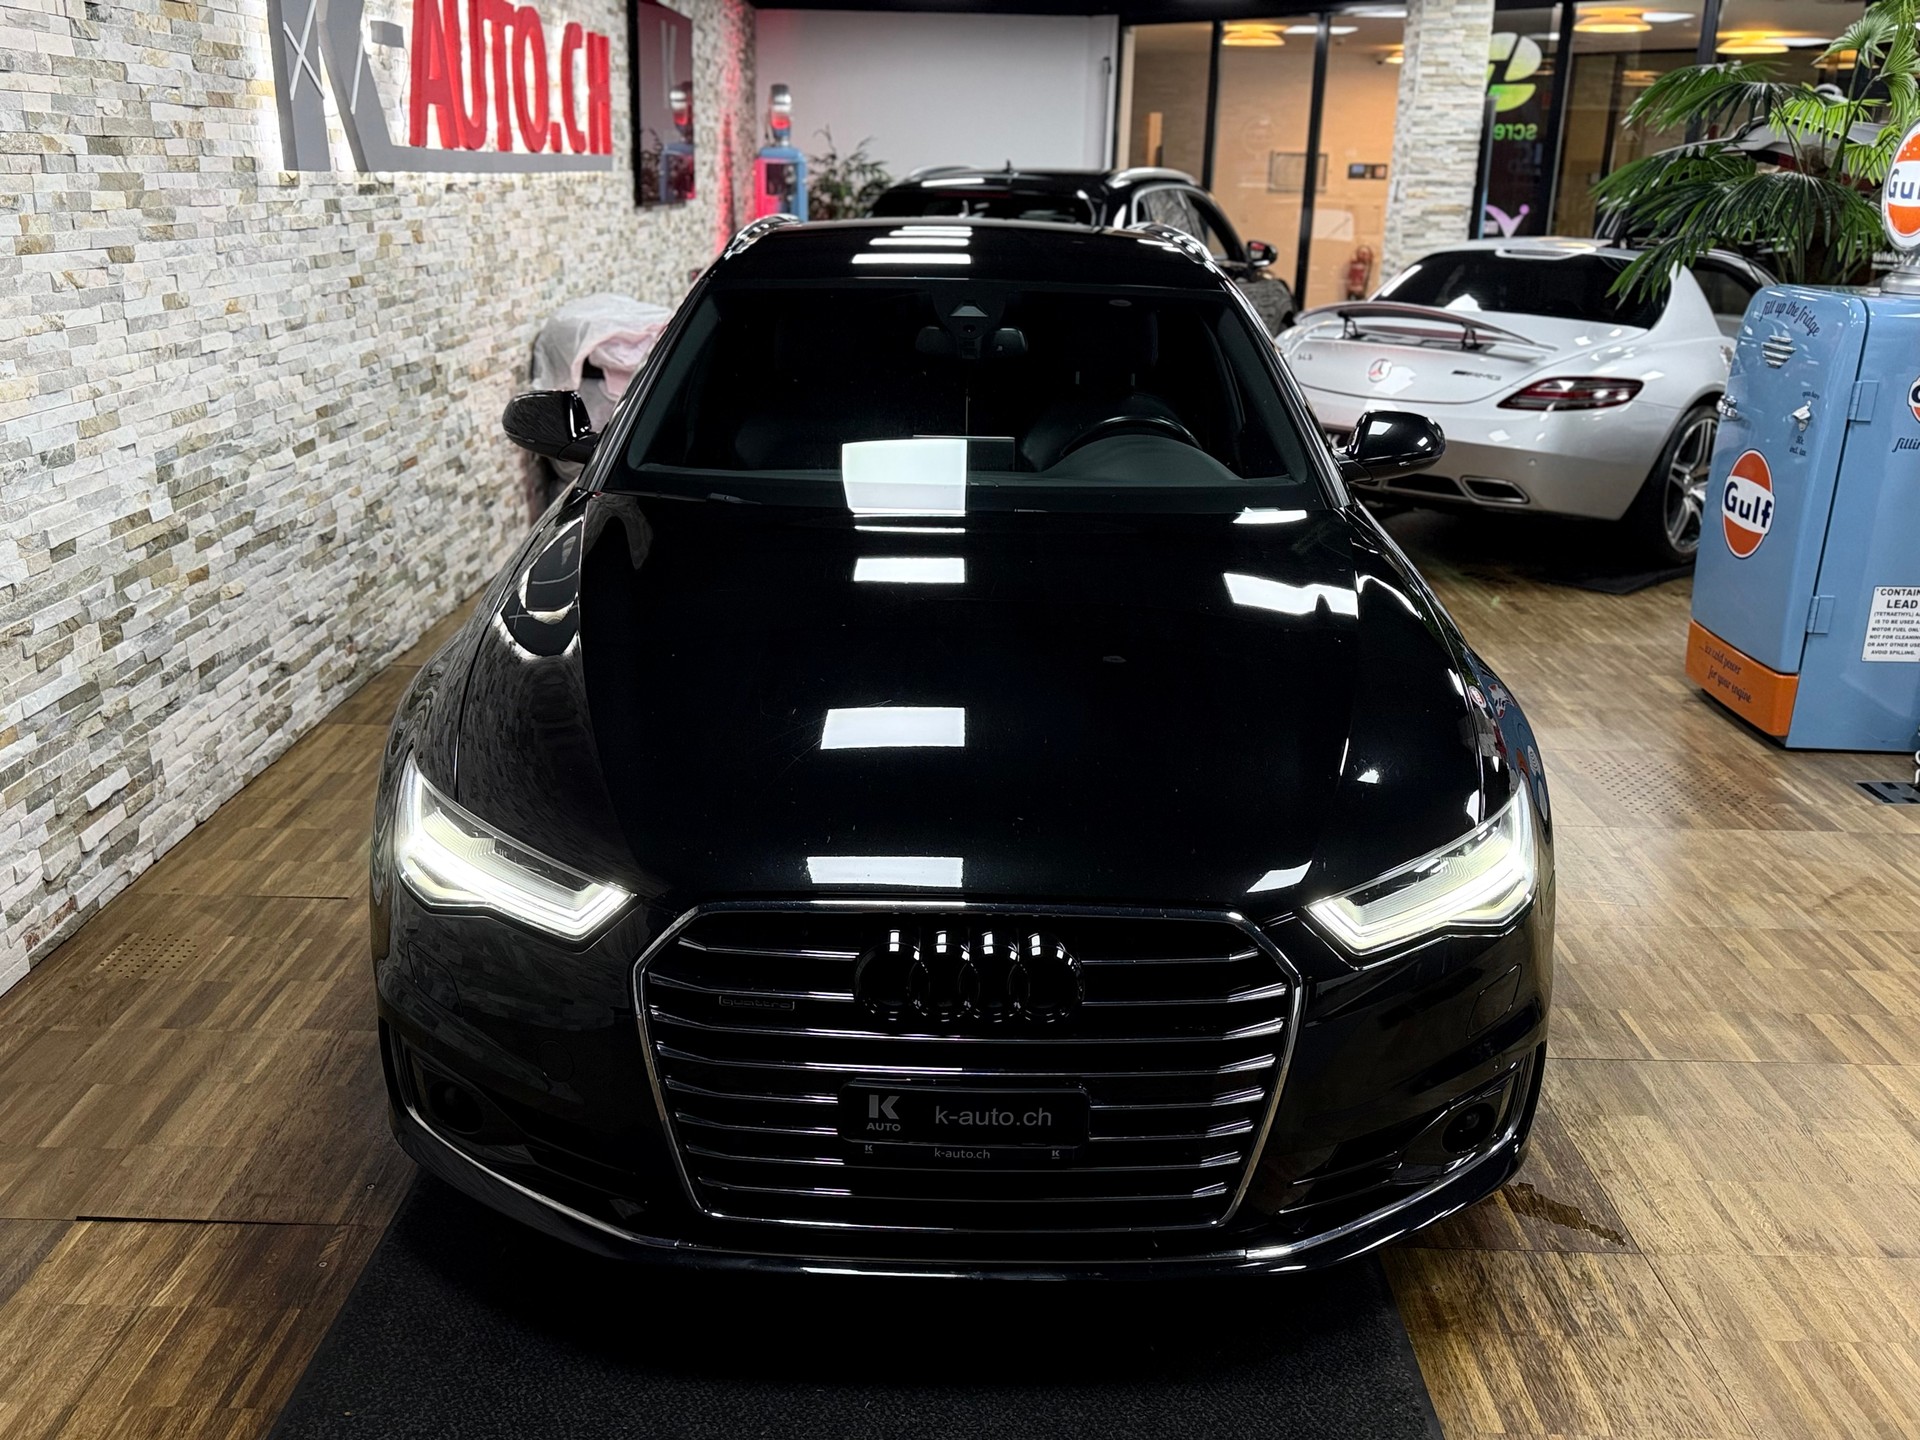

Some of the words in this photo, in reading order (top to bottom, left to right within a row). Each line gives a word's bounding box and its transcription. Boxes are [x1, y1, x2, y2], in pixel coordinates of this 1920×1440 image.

[1759, 300, 1776, 322] fill
[1775, 303, 1787, 318] up
[1785, 301, 1800, 317] the
[1793, 305, 1820, 337] fridge
[1724, 481, 1773, 529] Gulf
[1886, 599, 1918, 609] LEAD
[1731, 684, 1752, 704] engine
[722, 998, 791, 1009] quattro
[868, 1094, 900, 1120] K
[934, 1105, 1052, 1126] k-auto.ch
[866, 1122, 901, 1132] AUTO
[934, 1147, 990, 1159] k-auto.ch
